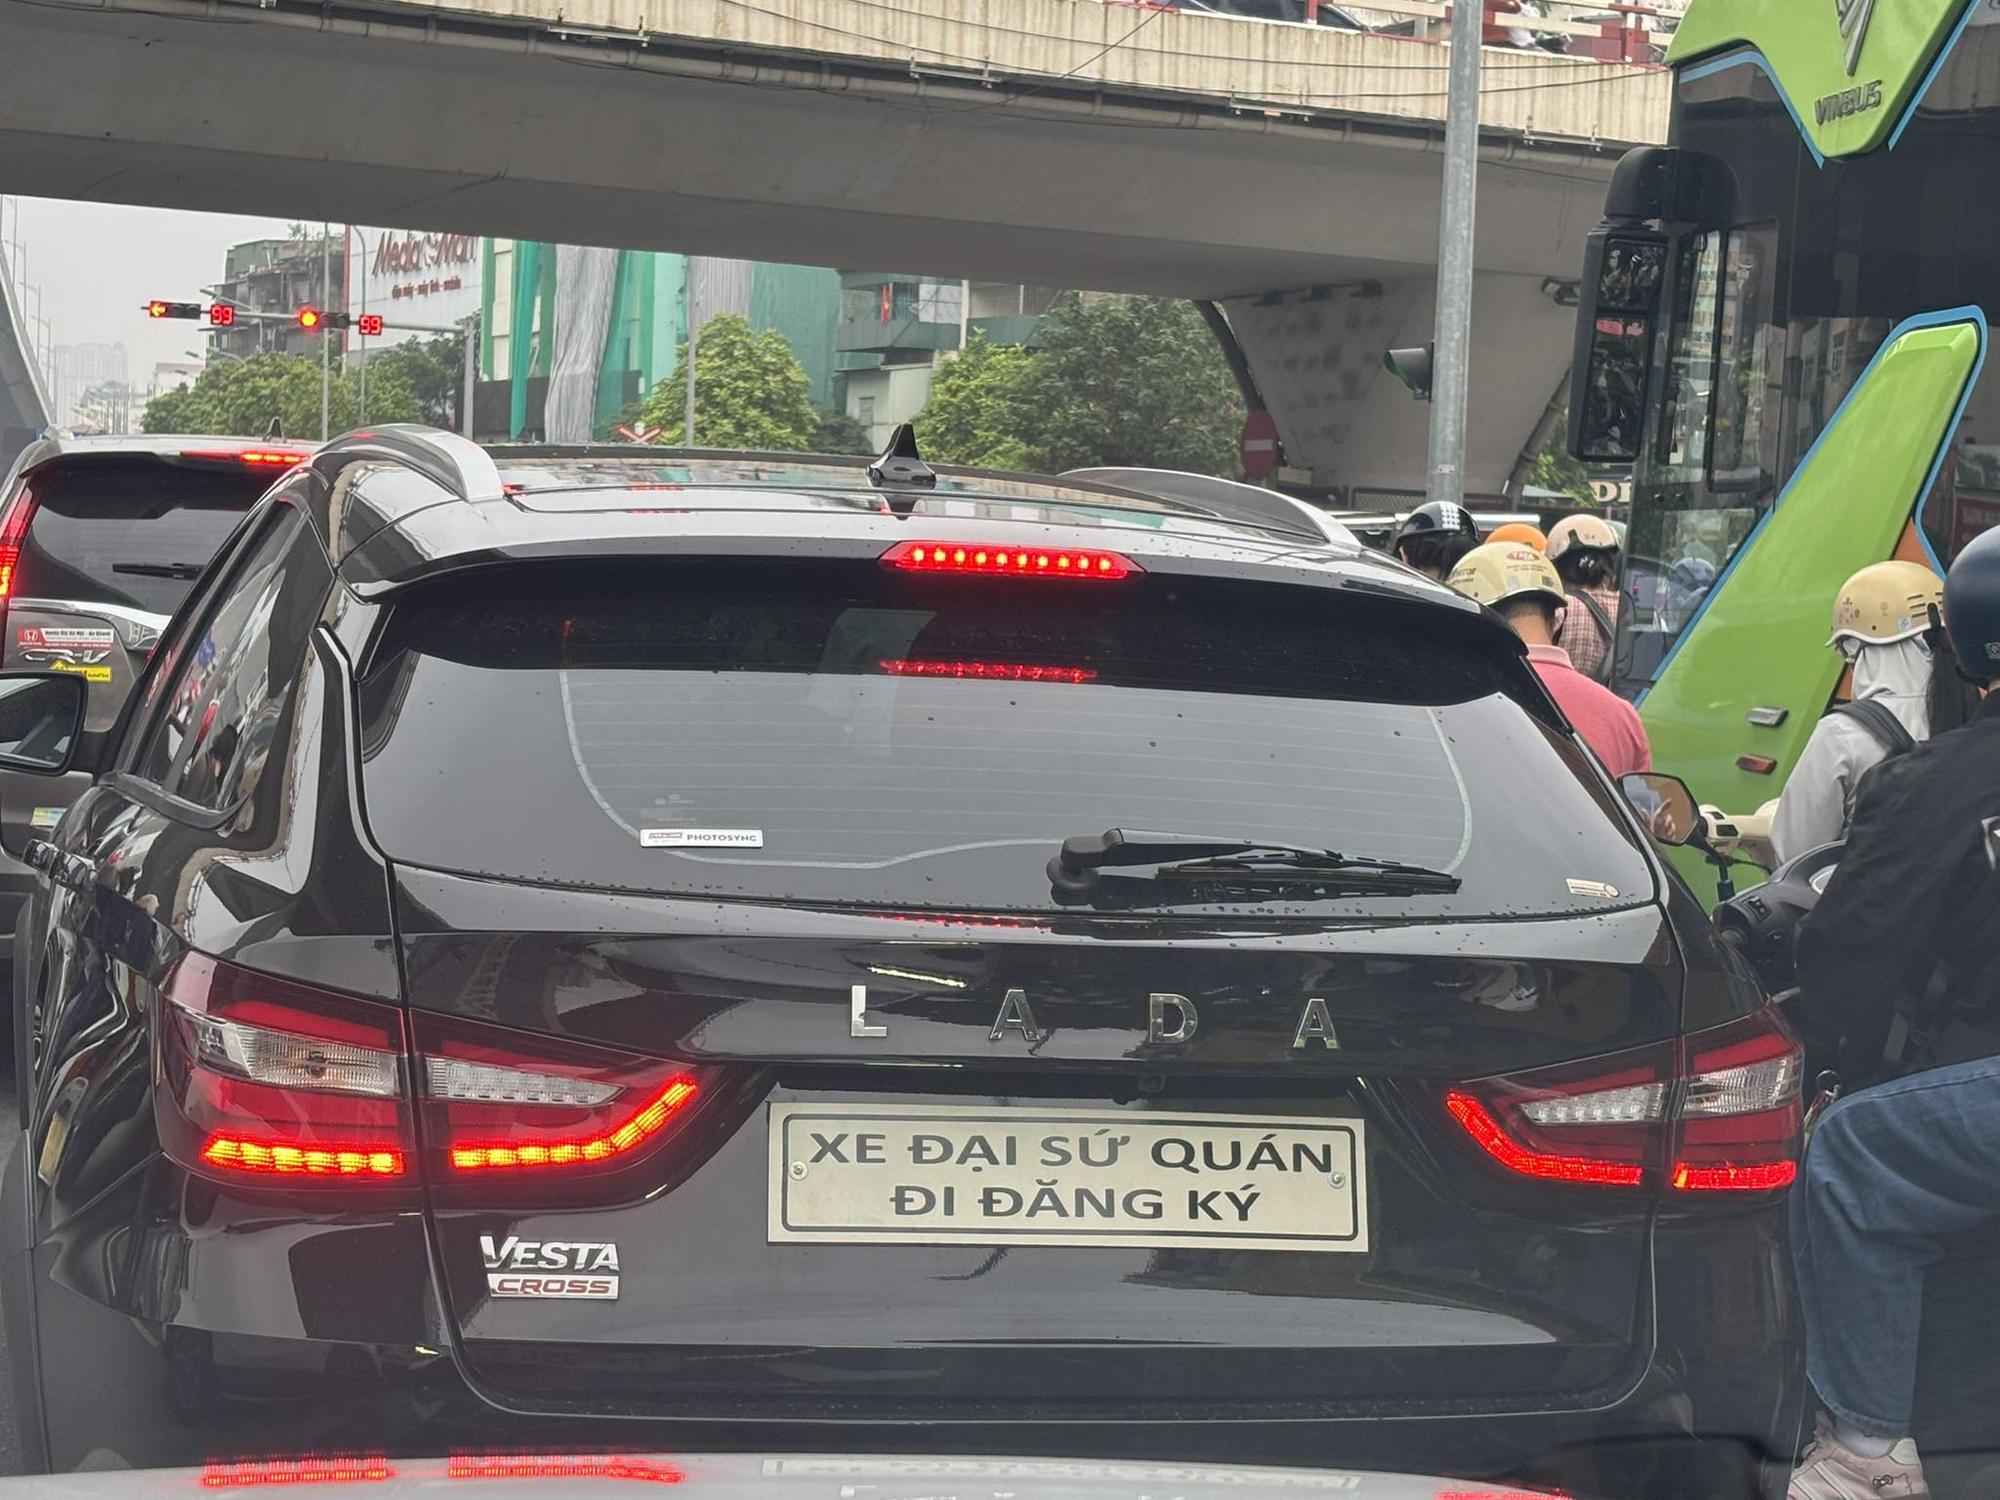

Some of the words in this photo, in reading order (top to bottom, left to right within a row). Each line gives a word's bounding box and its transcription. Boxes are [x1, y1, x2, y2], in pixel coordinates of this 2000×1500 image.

[1814, 79, 1882, 126] VINBUS
[210, 305, 234, 326] 99
[360, 315, 383, 335] 99
[18, 648, 112, 665] CR-V
[686, 833, 758, 843] PHOTOSYNC
[850, 984, 1341, 1050] LADA
[809, 1132, 887, 1164] XE
[906, 1134, 1017, 1173] ĐẠI
[1040, 1128, 1131, 1168] SỨ
[1150, 1133, 1333, 1174] QUÁN
[889, 1185, 955, 1217] ĐI
[977, 1178, 1164, 1220] ĐĂNG
[1187, 1183, 1262, 1222] KÝ
[479, 1235, 621, 1272] VESTA
[496, 1278, 612, 1296] CROSS
